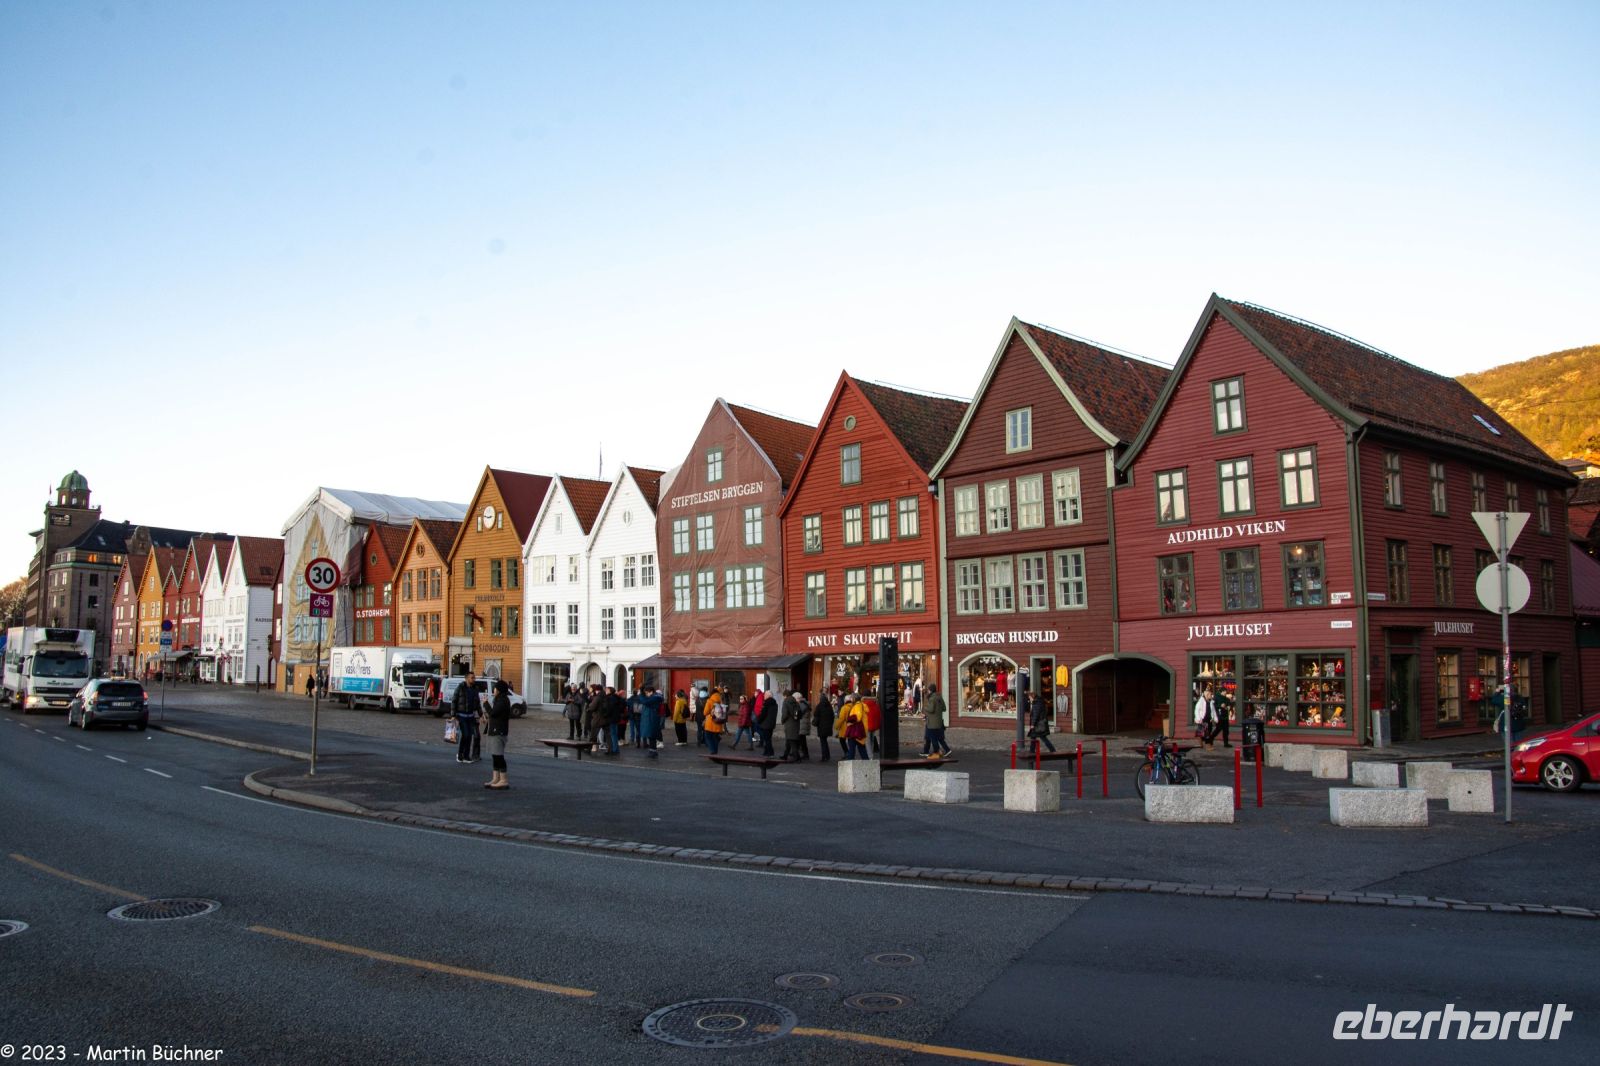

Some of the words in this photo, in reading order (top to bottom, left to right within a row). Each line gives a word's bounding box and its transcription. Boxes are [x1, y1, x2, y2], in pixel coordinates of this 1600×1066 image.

[671, 489, 721, 509] STIFTELSEN
[721, 481, 763, 500] BRYGGEN
[1167, 526, 1233, 544] AUDHILD
[1235, 519, 1286, 537] VIKEN
[311, 566, 334, 585] 30
[956, 632, 1006, 644] BRYGGEN
[1008, 630, 1058, 643] HUSFLID
[1187, 622, 1273, 641] JULEHUSET
[1433, 621, 1475, 636] JULEHUSET
[807, 635, 837, 647] KNUT
